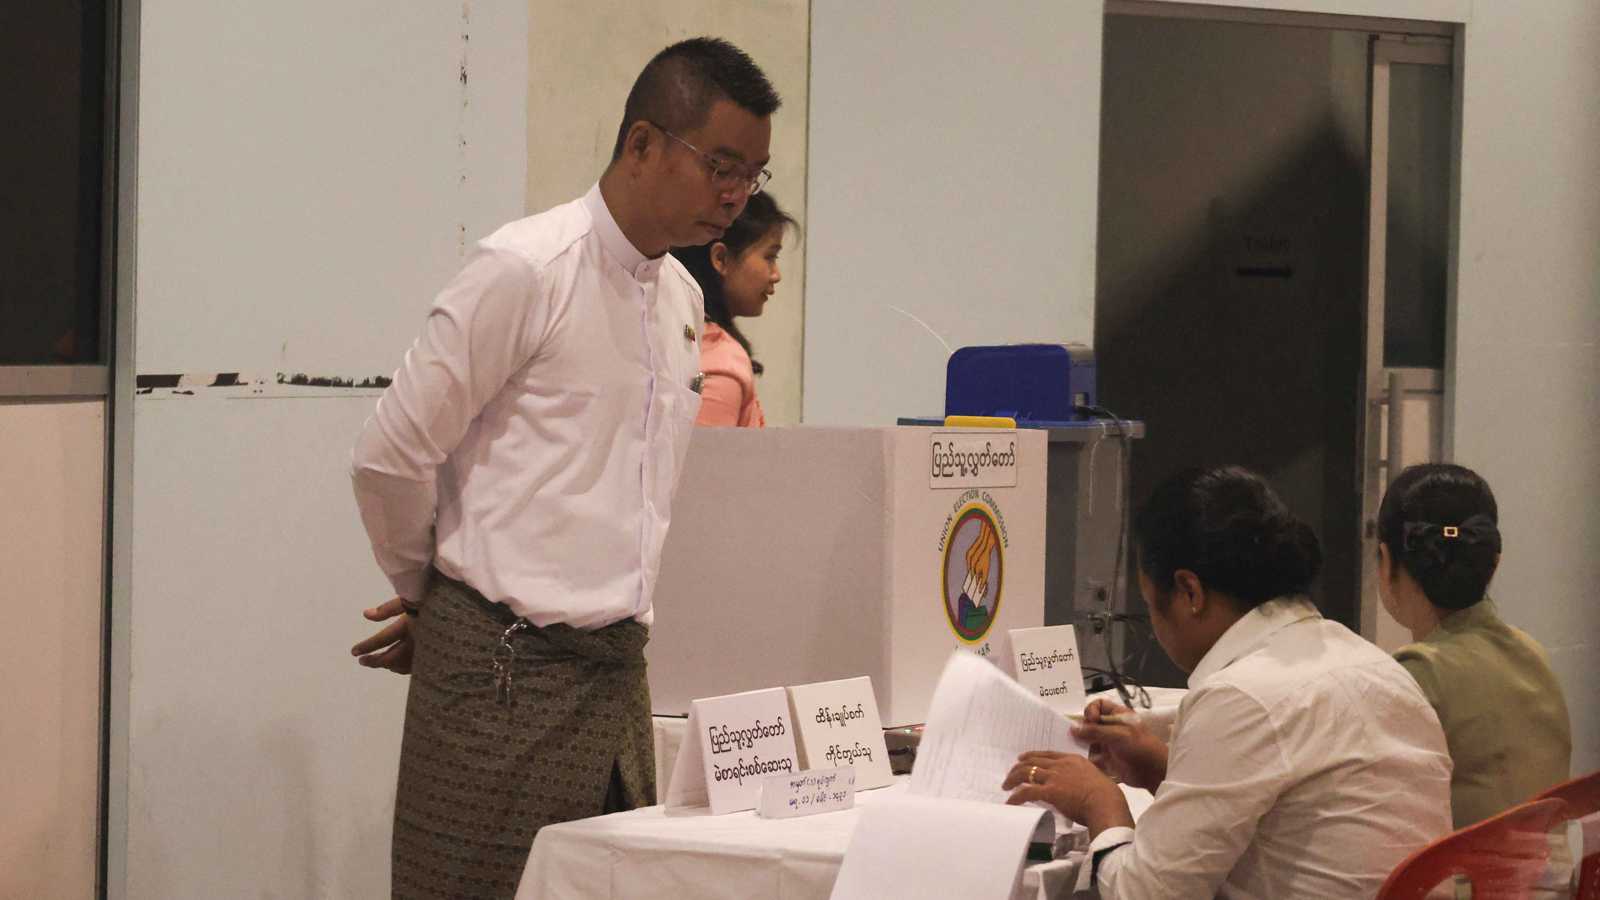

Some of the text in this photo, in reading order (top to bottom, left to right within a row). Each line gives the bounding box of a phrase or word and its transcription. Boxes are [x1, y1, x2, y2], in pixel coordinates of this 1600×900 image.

[931, 441, 1016, 478] ပြည်သူ့လွှတ်တော်
[938, 513, 953, 553] UNION
[953, 488, 980, 512] ELECTION
[709, 716, 785, 754] ပြည်သူ့လွှတ်တော်
[713, 755, 793, 786] မဲစာရင်းစစ်ဆေးသူ
[825, 742, 873, 767] ကိုင်တွယ်သူ
